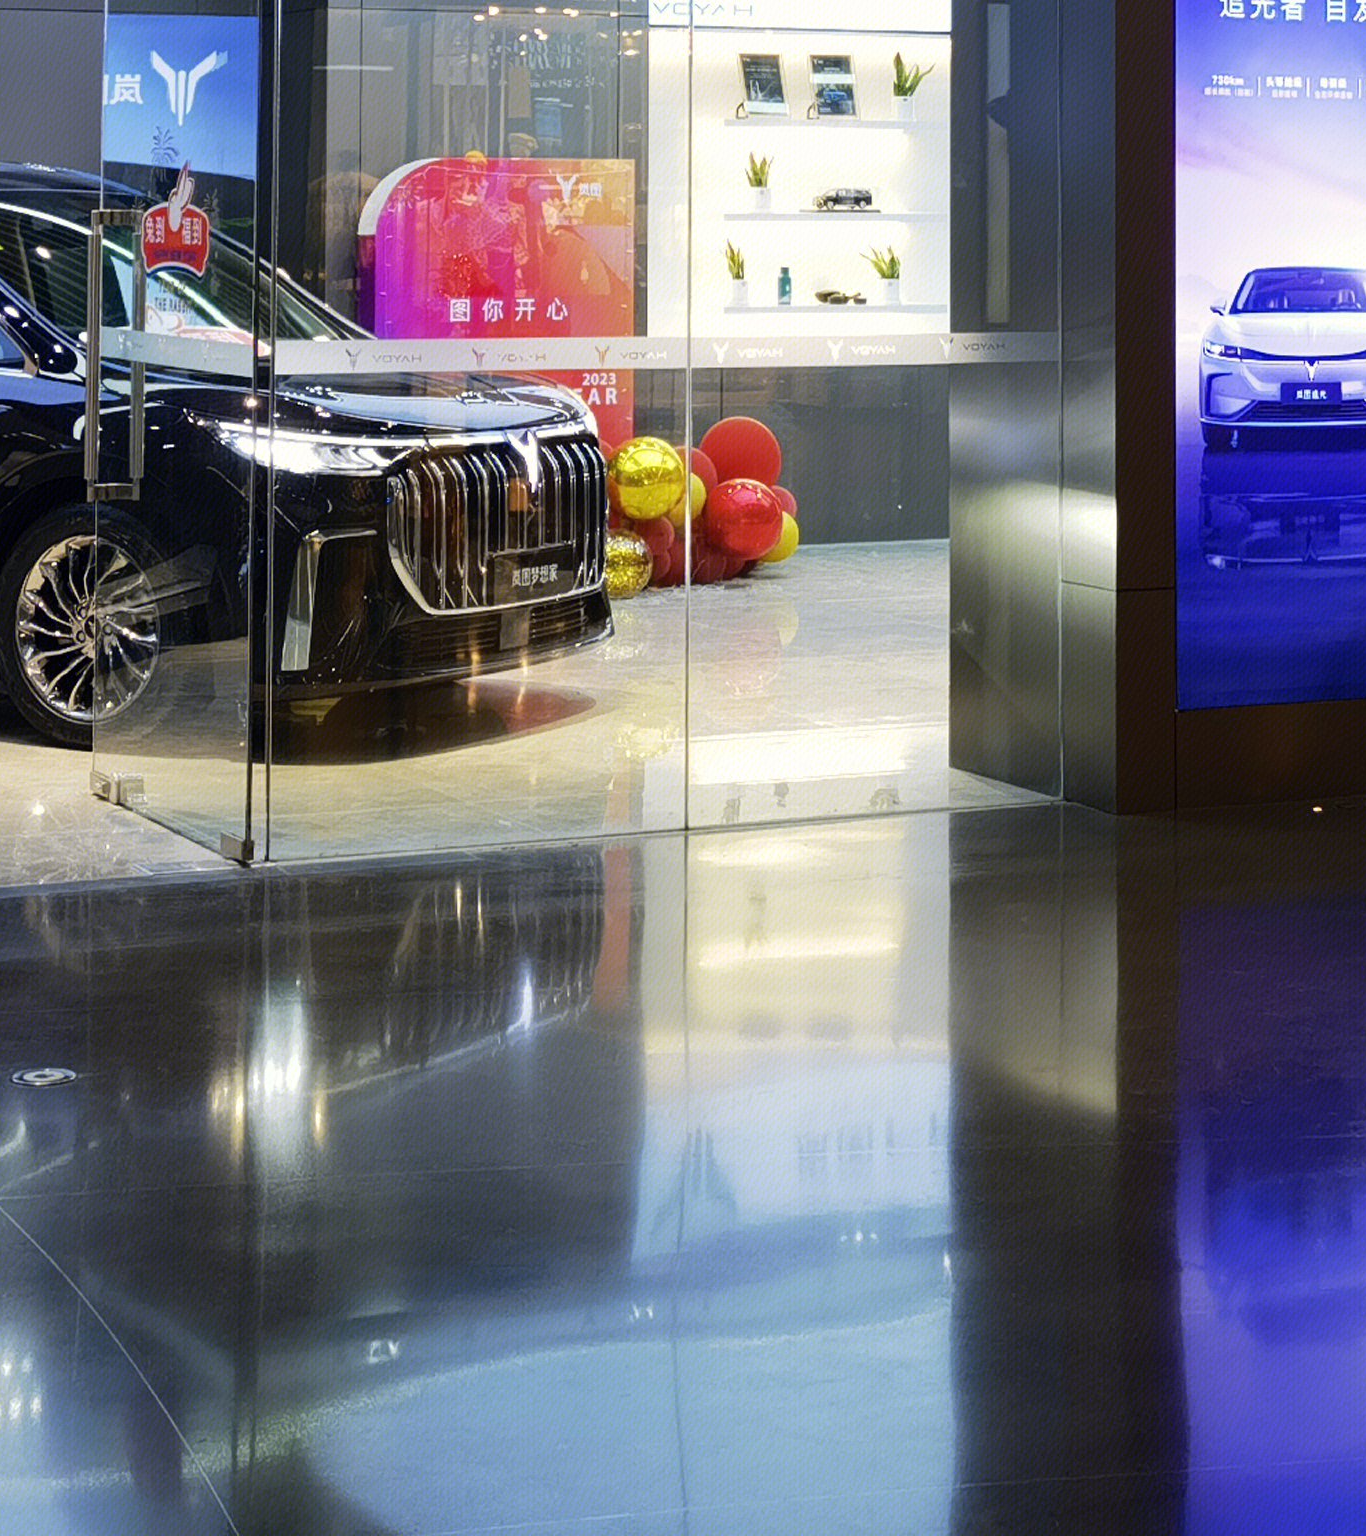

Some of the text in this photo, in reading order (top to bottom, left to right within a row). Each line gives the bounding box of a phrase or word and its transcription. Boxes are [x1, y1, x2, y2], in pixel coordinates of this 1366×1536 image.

[737, 346, 783, 359] VOYAH
[850, 344, 896, 355] VOYAH
[963, 343, 1006, 352] VOYAH
[372, 353, 422, 364] VOYAH
[620, 350, 667, 361] VOYAH
[582, 372, 617, 386] 2023
